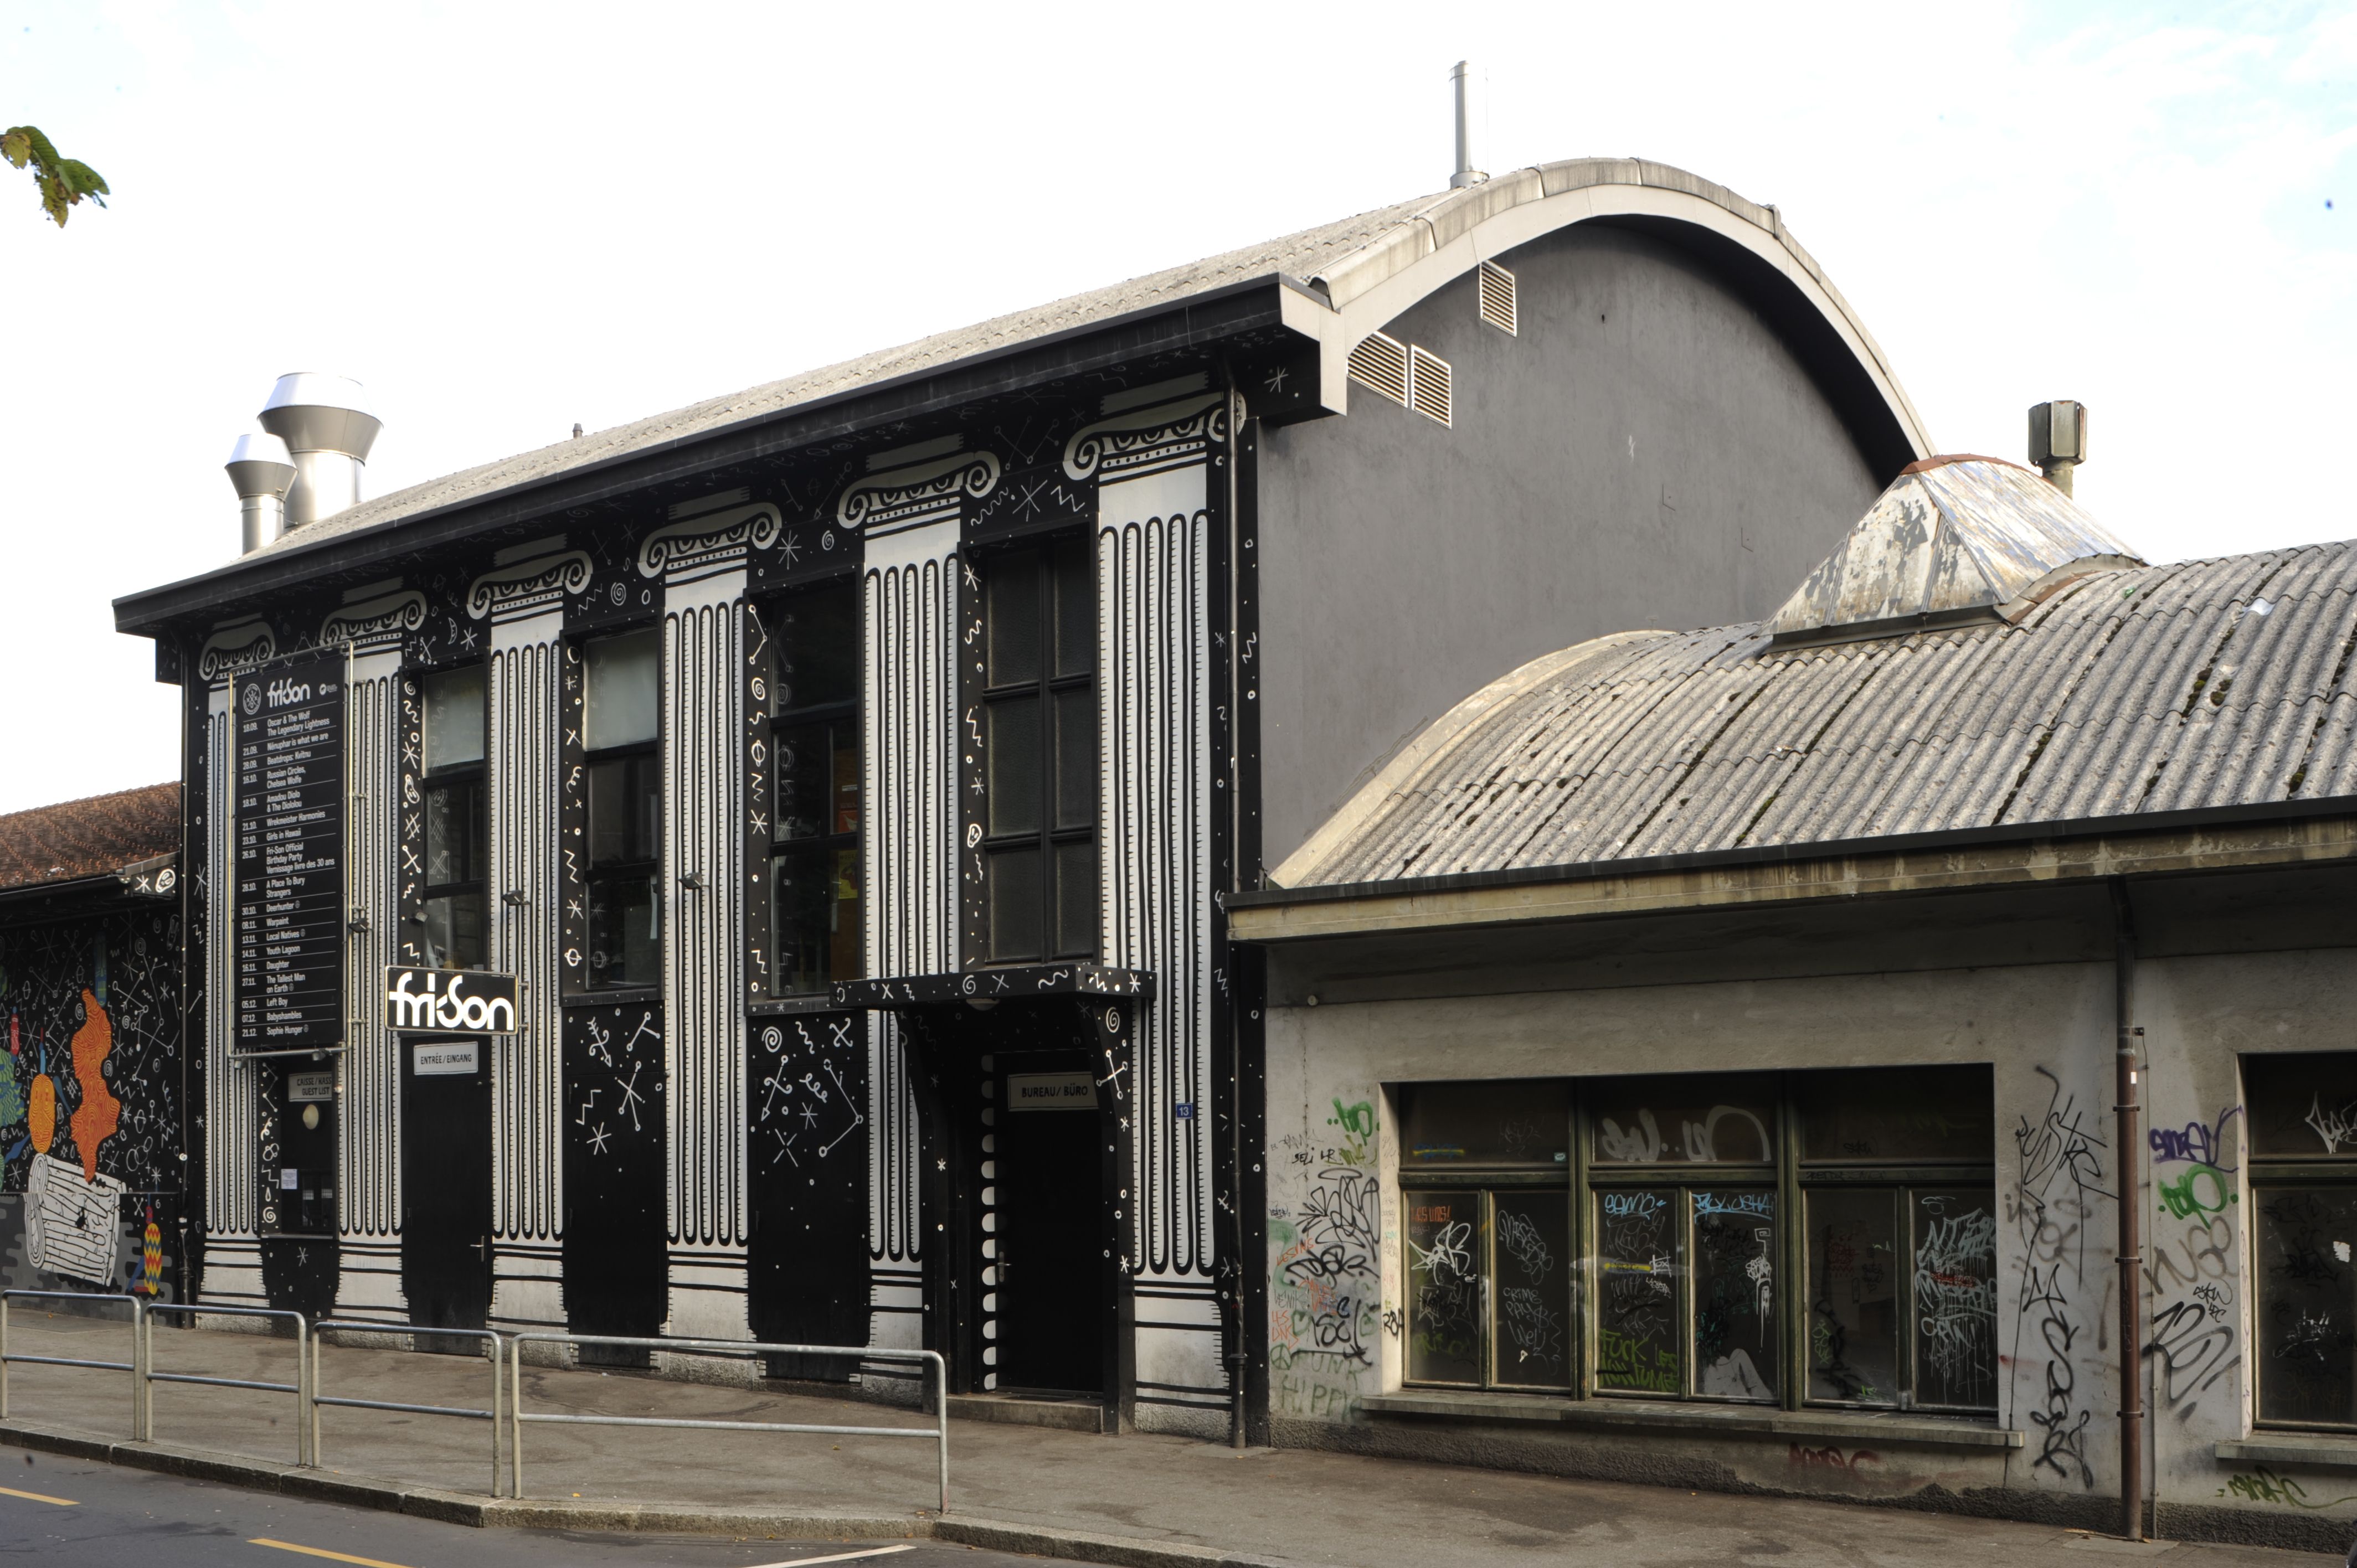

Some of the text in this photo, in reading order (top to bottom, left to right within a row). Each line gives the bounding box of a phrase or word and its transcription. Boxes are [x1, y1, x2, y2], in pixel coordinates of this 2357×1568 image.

[267, 718, 281, 727] Oscar
[288, 714, 297, 723] The
[299, 710, 310, 720] Wolf
[267, 718, 330, 736] The Legendary Lightness
[267, 740, 291, 751] Nénuphar
[298, 735, 310, 745] what
[267, 766, 306, 780] Russian Circles,
[267, 776, 302, 789] Chelsea Wolfe
[267, 794, 286, 803] Amadou
[272, 803, 281, 811] The
[267, 811, 326, 826] Wrekmeister Harmonies
[266, 832, 278, 841] Girls
[285, 828, 301, 837] Hawaii
[266, 842, 303, 855] Fri-Son Official
[266, 853, 303, 865] Birthday Party
[266, 864, 293, 874] Vernissage
[317, 858, 324, 867] 30
[271, 879, 285, 888] Place
[293, 876, 305, 886] Bury
[266, 888, 291, 898] Strangers
[266, 902, 295, 912] Deerhunter
[266, 917, 289, 927] Warpaint
[266, 930, 300, 941] Local Natives
[266, 945, 300, 956] Youth Lagoon
[266, 961, 290, 971] Daughter
[267, 976, 275, 984] The
[277, 974, 293, 983] Tallest
[274, 983, 288, 992] Earth
[279, 998, 288, 1007] Boy
[267, 1011, 302, 1022] Babyshambles
[267, 1026, 303, 1036] Sophie Hunger
[302, 1087, 317, 1096] GUEST
[1179, 1106, 1188, 1116] 13
